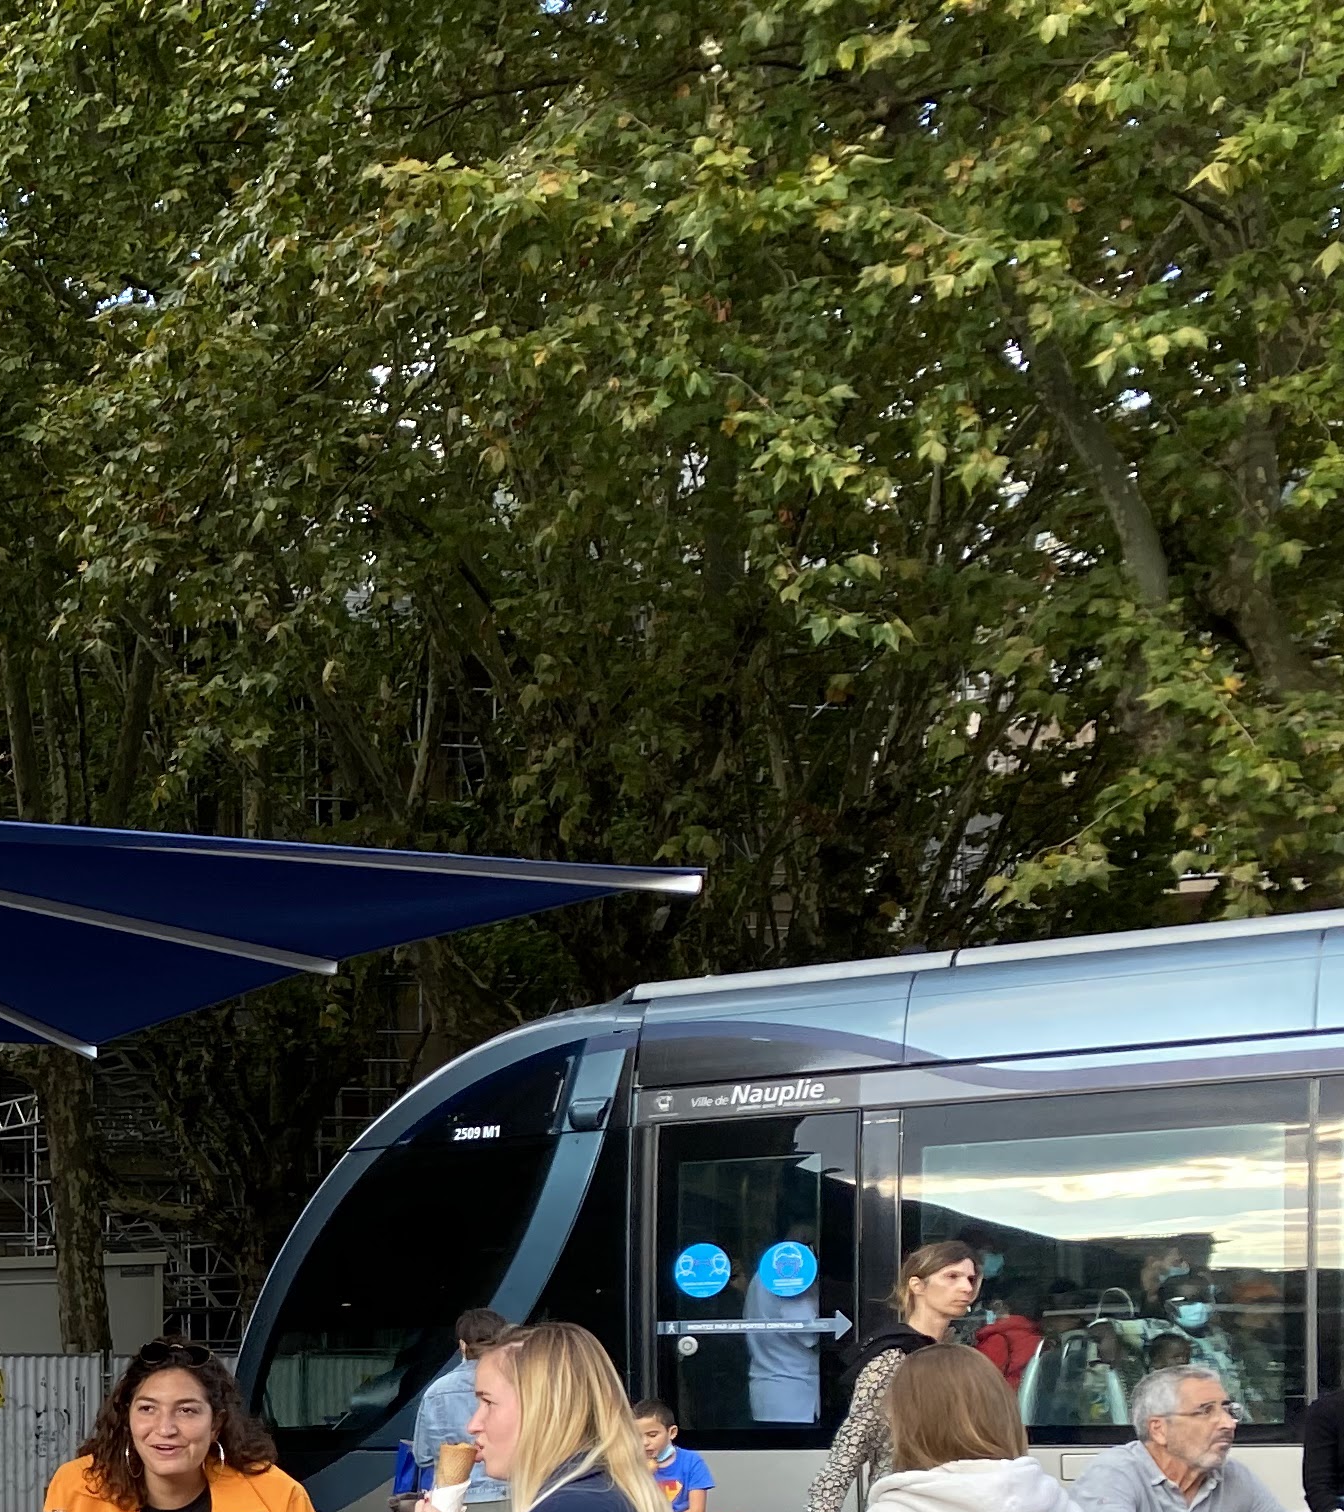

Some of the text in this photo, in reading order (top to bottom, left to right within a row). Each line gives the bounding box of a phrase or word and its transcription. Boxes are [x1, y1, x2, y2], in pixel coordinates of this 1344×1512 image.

[690, 1096, 713, 1108] Ville
[714, 1095, 730, 1106] de
[730, 1078, 826, 1106] Nauplie
[453, 1124, 501, 1141] 2509 M1
